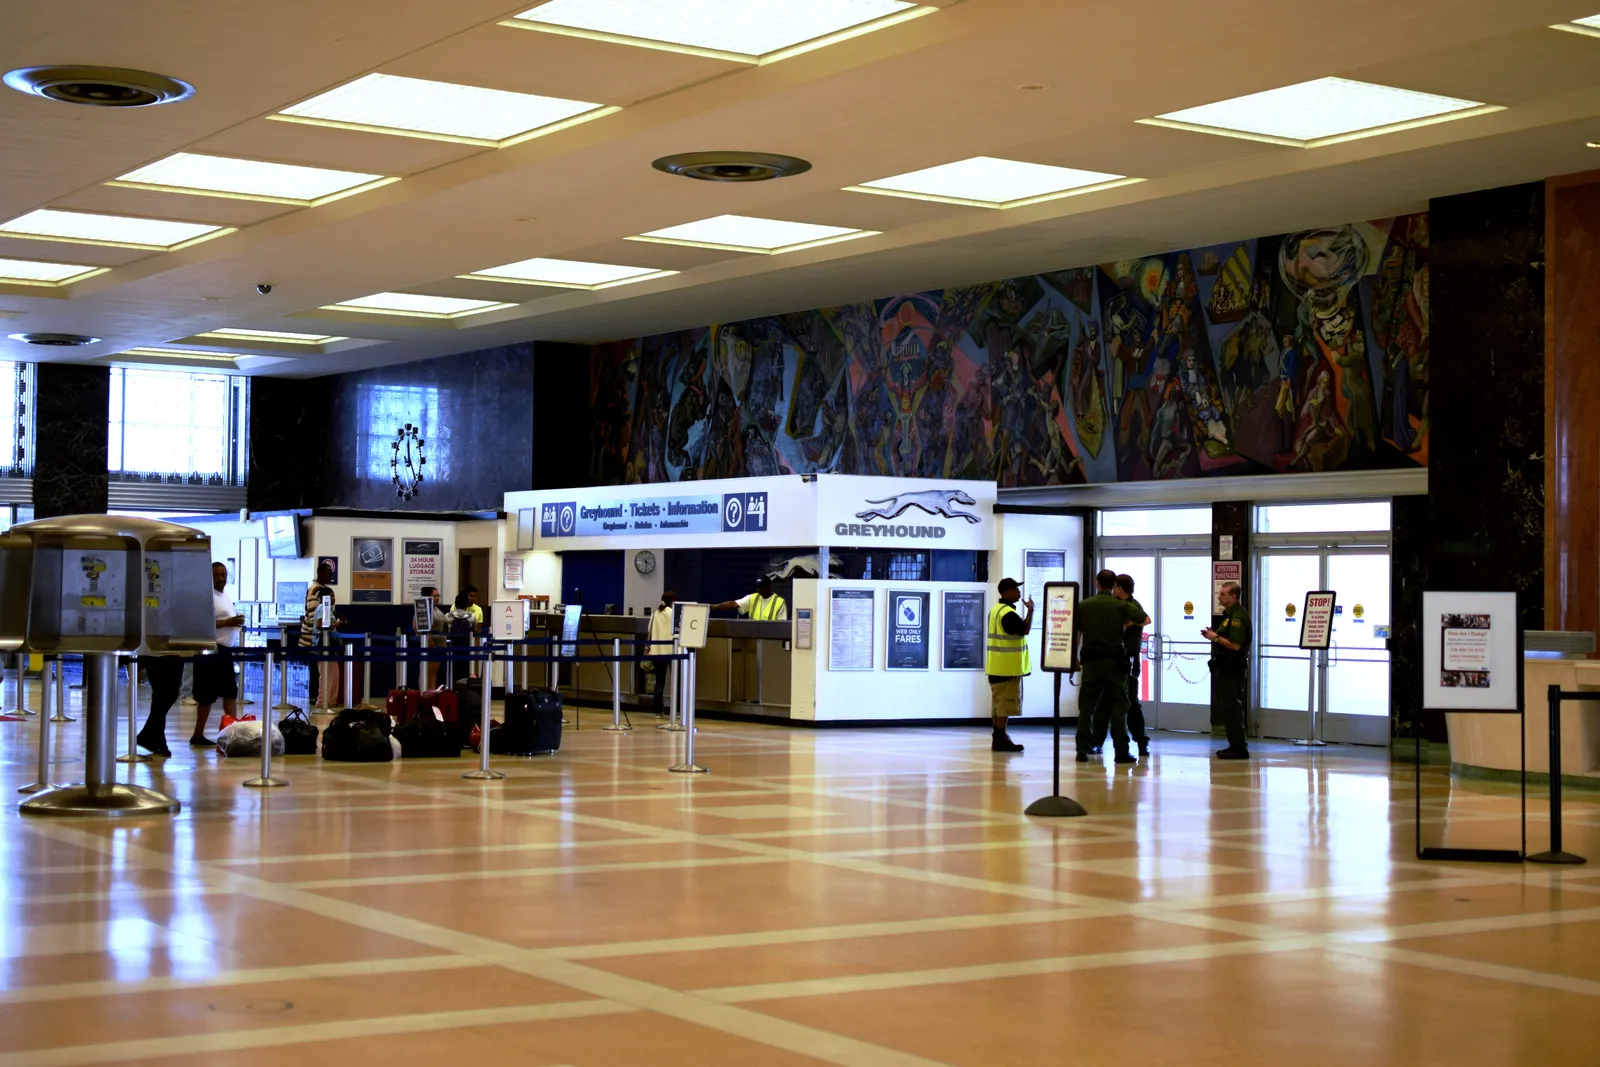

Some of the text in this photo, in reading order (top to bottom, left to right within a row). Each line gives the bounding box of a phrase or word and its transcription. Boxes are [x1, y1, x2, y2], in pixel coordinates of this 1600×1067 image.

[580, 500, 718, 521] Greyhound Tickets Information
[834, 522, 946, 538] GREYHOUND
[1309, 598, 1330, 607] STOP!
[690, 619, 698, 630] C
[895, 635, 921, 643] FARES
